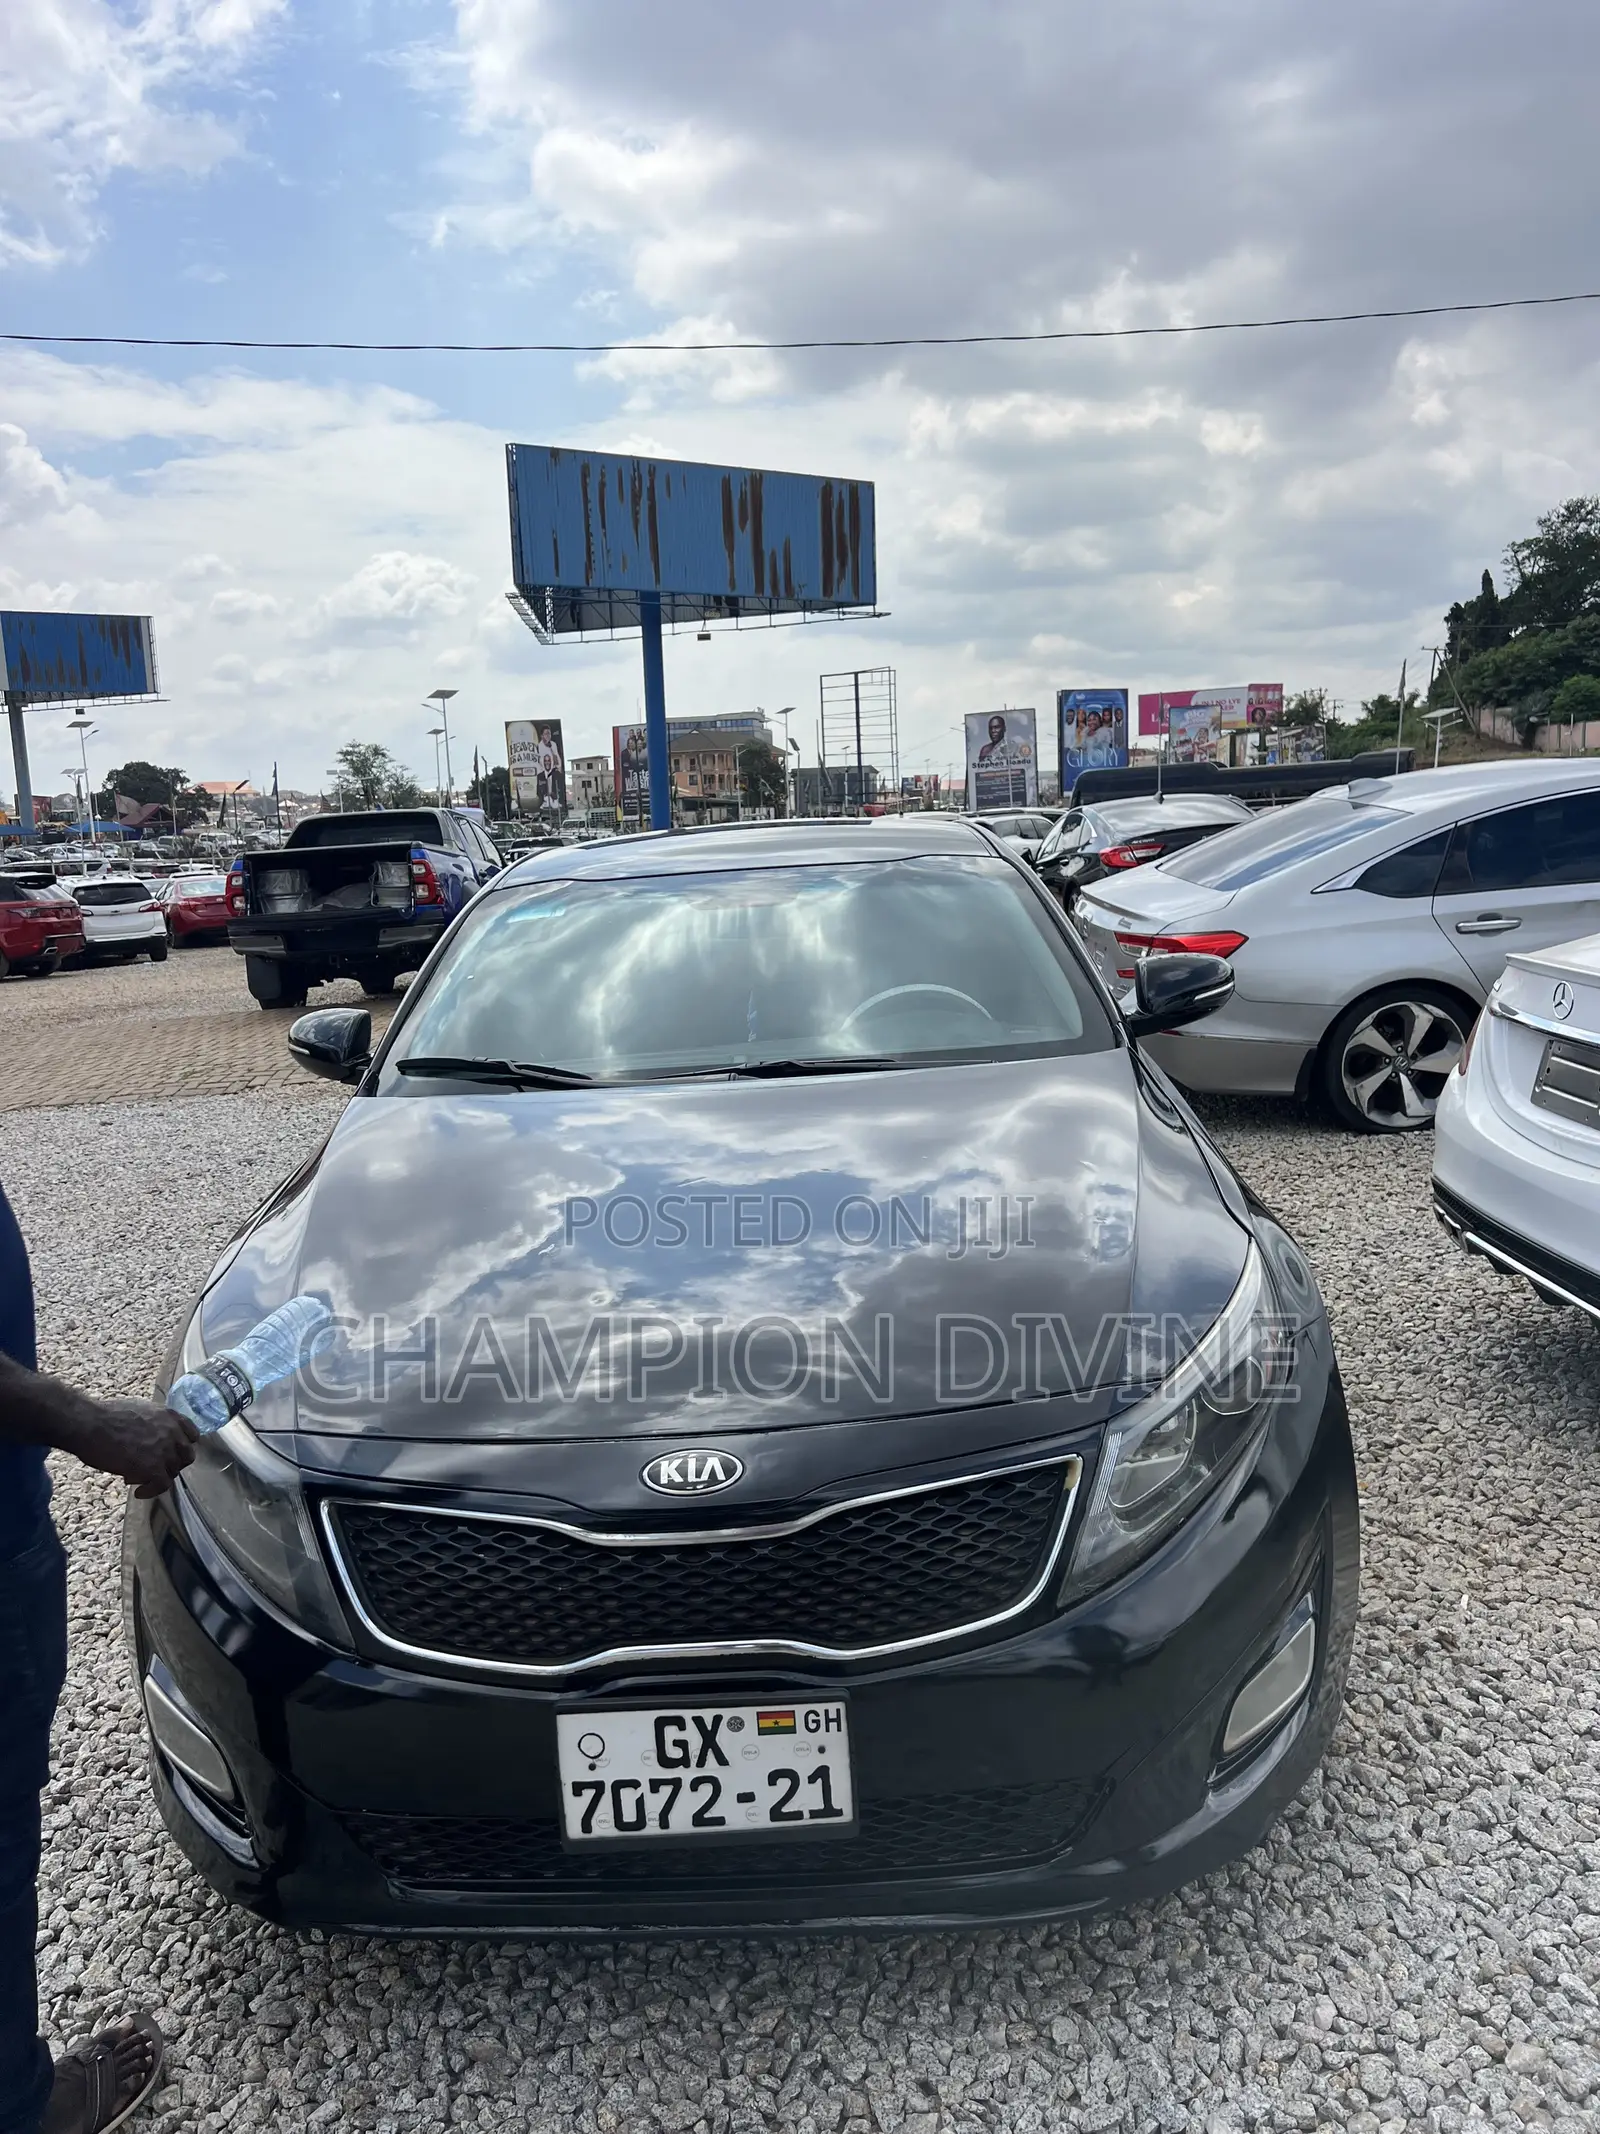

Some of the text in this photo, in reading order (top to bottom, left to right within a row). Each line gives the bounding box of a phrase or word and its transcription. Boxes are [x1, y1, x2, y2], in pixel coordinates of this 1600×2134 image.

[972, 760, 1004, 769] Stephen
[1066, 747, 1118, 768] GLORY
[660, 1457, 726, 1484] KIA
[804, 1708, 842, 1733] GH
[654, 1714, 731, 1768] GX
[571, 1765, 844, 1834] 7072-21
